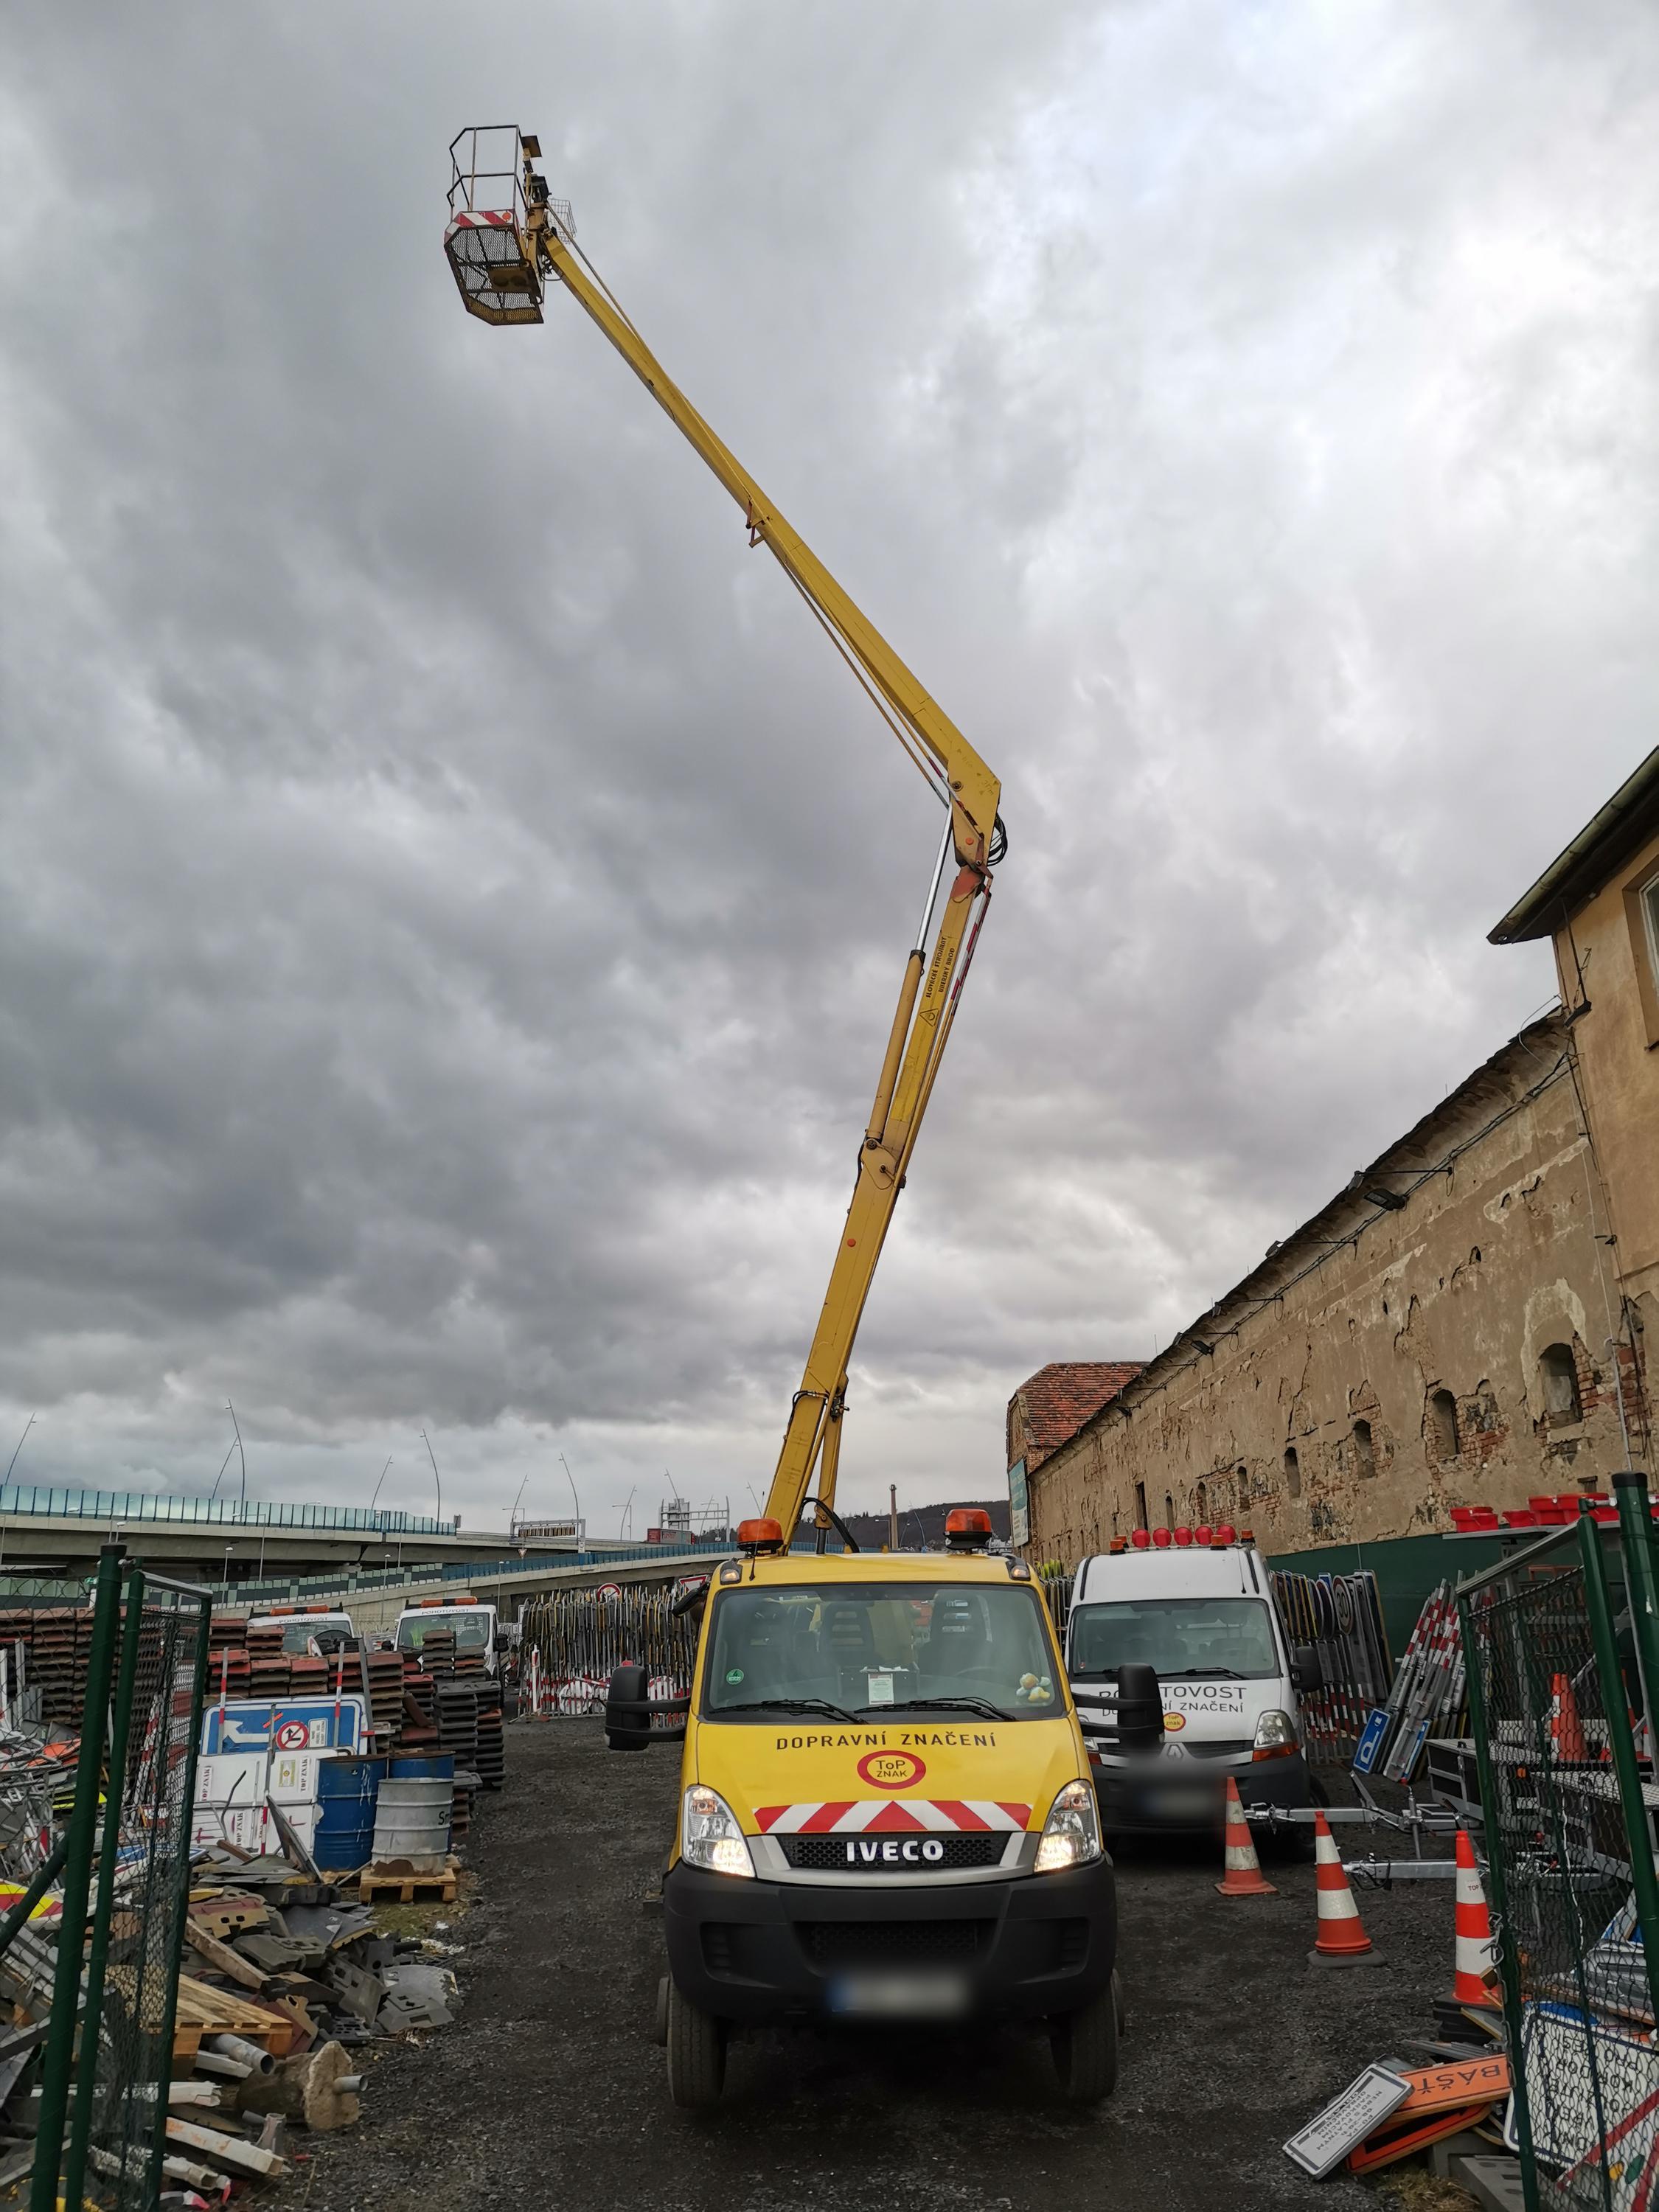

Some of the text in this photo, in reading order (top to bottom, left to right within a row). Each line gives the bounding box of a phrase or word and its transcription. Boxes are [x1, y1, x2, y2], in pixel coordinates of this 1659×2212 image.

[946, 947, 955, 966] BROD
[1180, 1701, 1244, 1713] ZNAČENÍ
[776, 1731, 997, 1750] DOPRAVNÍ ZNAČENÍ
[875, 1759, 906, 1770] ToP
[876, 1770, 908, 1778] ZNAK
[846, 1840, 944, 1863] IVECO
[1417, 2065, 1501, 2095] BÁŠŤ
